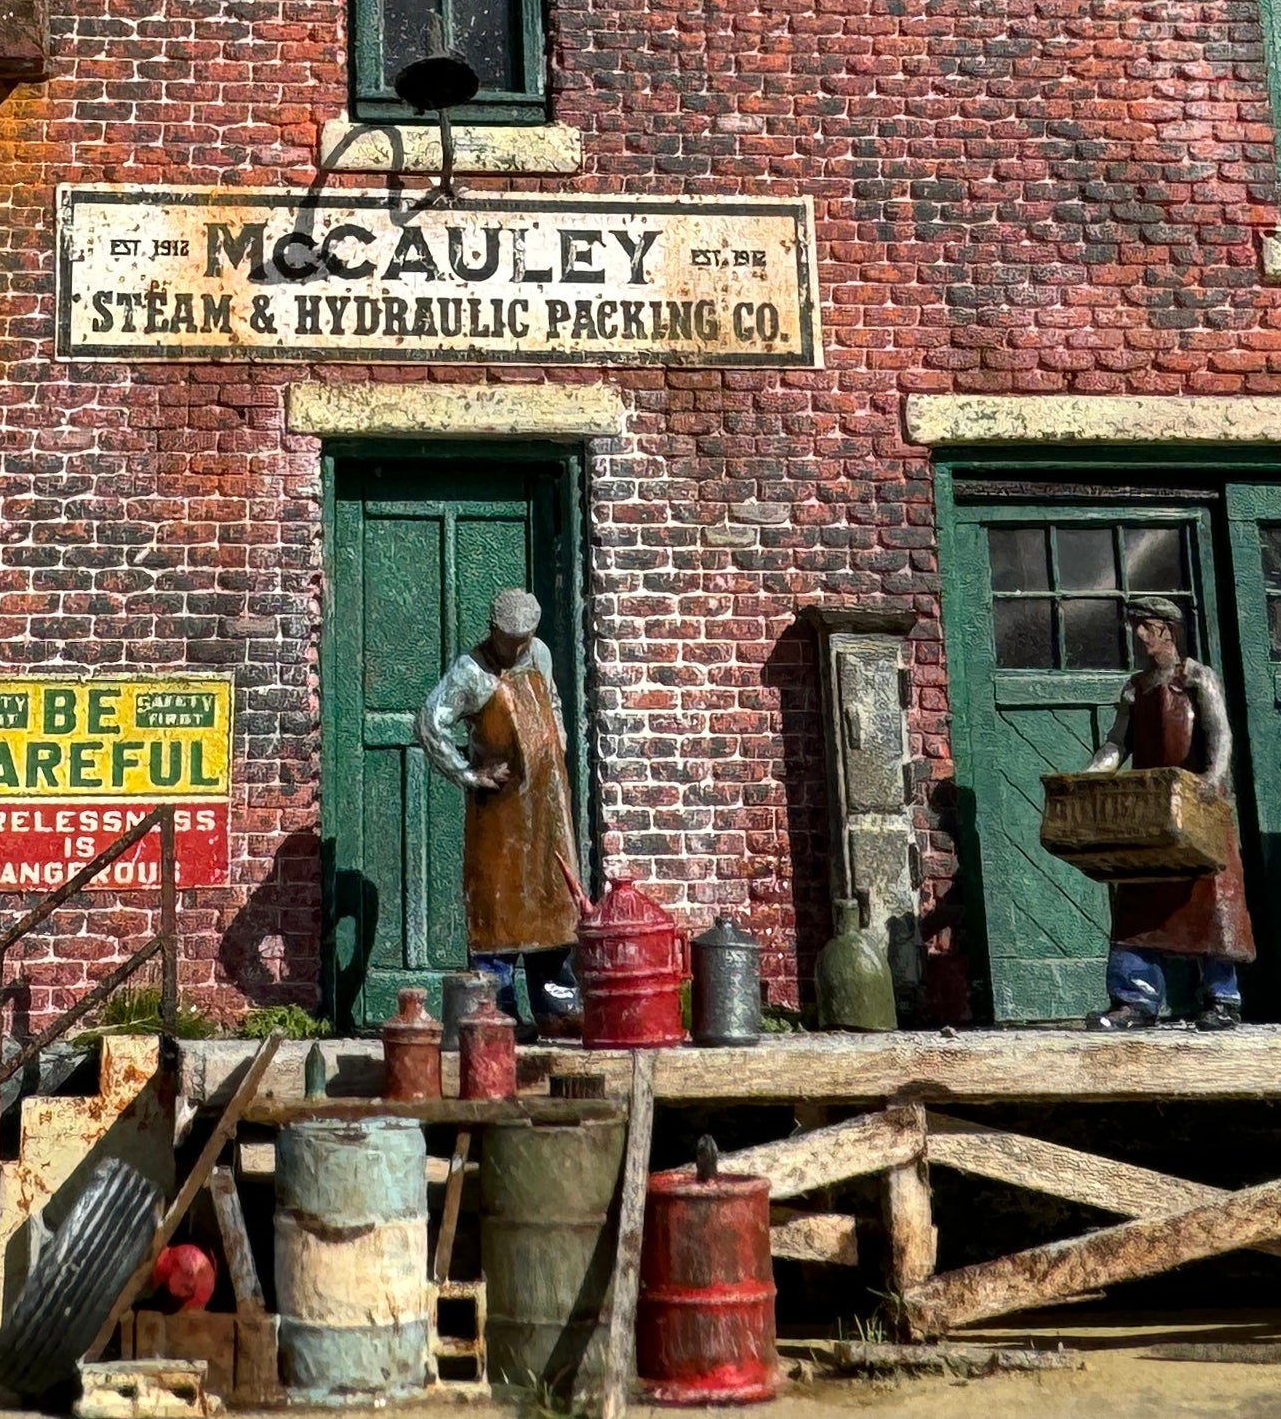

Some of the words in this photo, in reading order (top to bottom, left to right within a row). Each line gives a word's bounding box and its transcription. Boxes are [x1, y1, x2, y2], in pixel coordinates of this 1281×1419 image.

[204, 218, 663, 285] McCAULEY
[92, 290, 233, 334] STEAM
[250, 293, 278, 335] &
[295, 294, 530, 338] HYDRAULIC
[545, 299, 719, 342] PACKING
[733, 301, 791, 343] CO.
[42, 688, 121, 735] BE
[63, 835, 96, 859] IS
